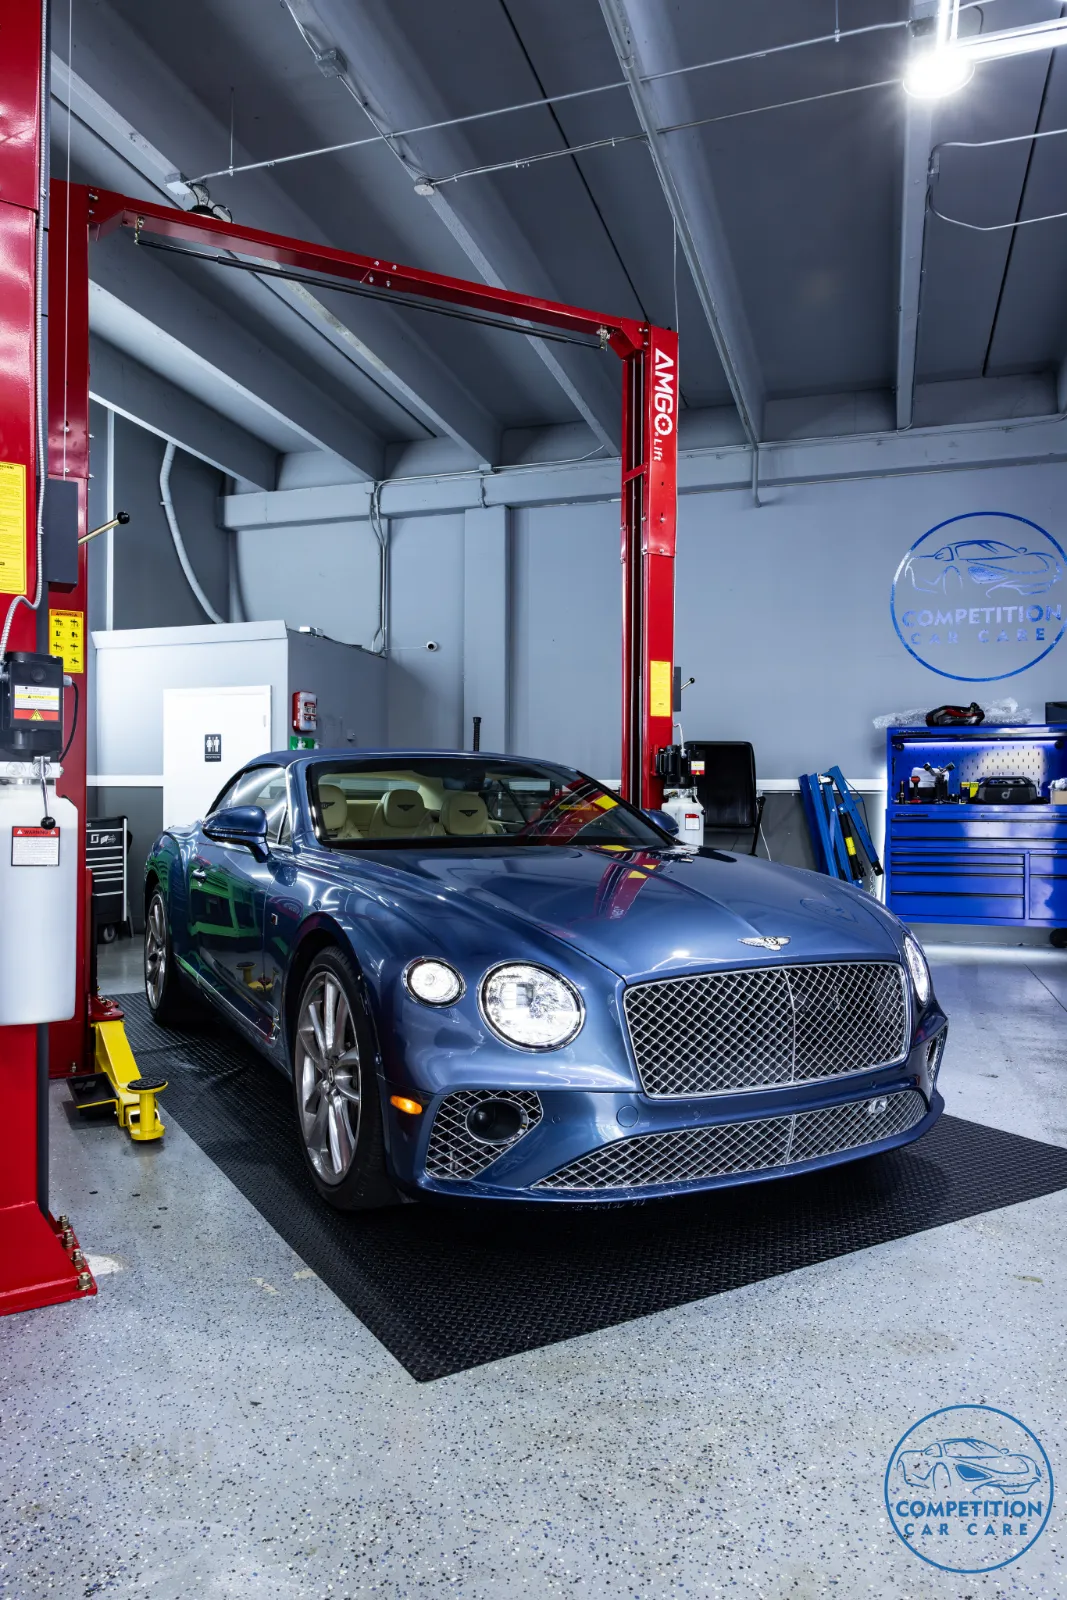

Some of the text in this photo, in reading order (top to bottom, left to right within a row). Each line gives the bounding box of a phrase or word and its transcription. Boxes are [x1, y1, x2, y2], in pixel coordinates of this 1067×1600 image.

[654, 348, 674, 461] AMGO Lift
[902, 604, 1062, 628] COMPETITION
[910, 627, 1045, 646] CAR CARE
